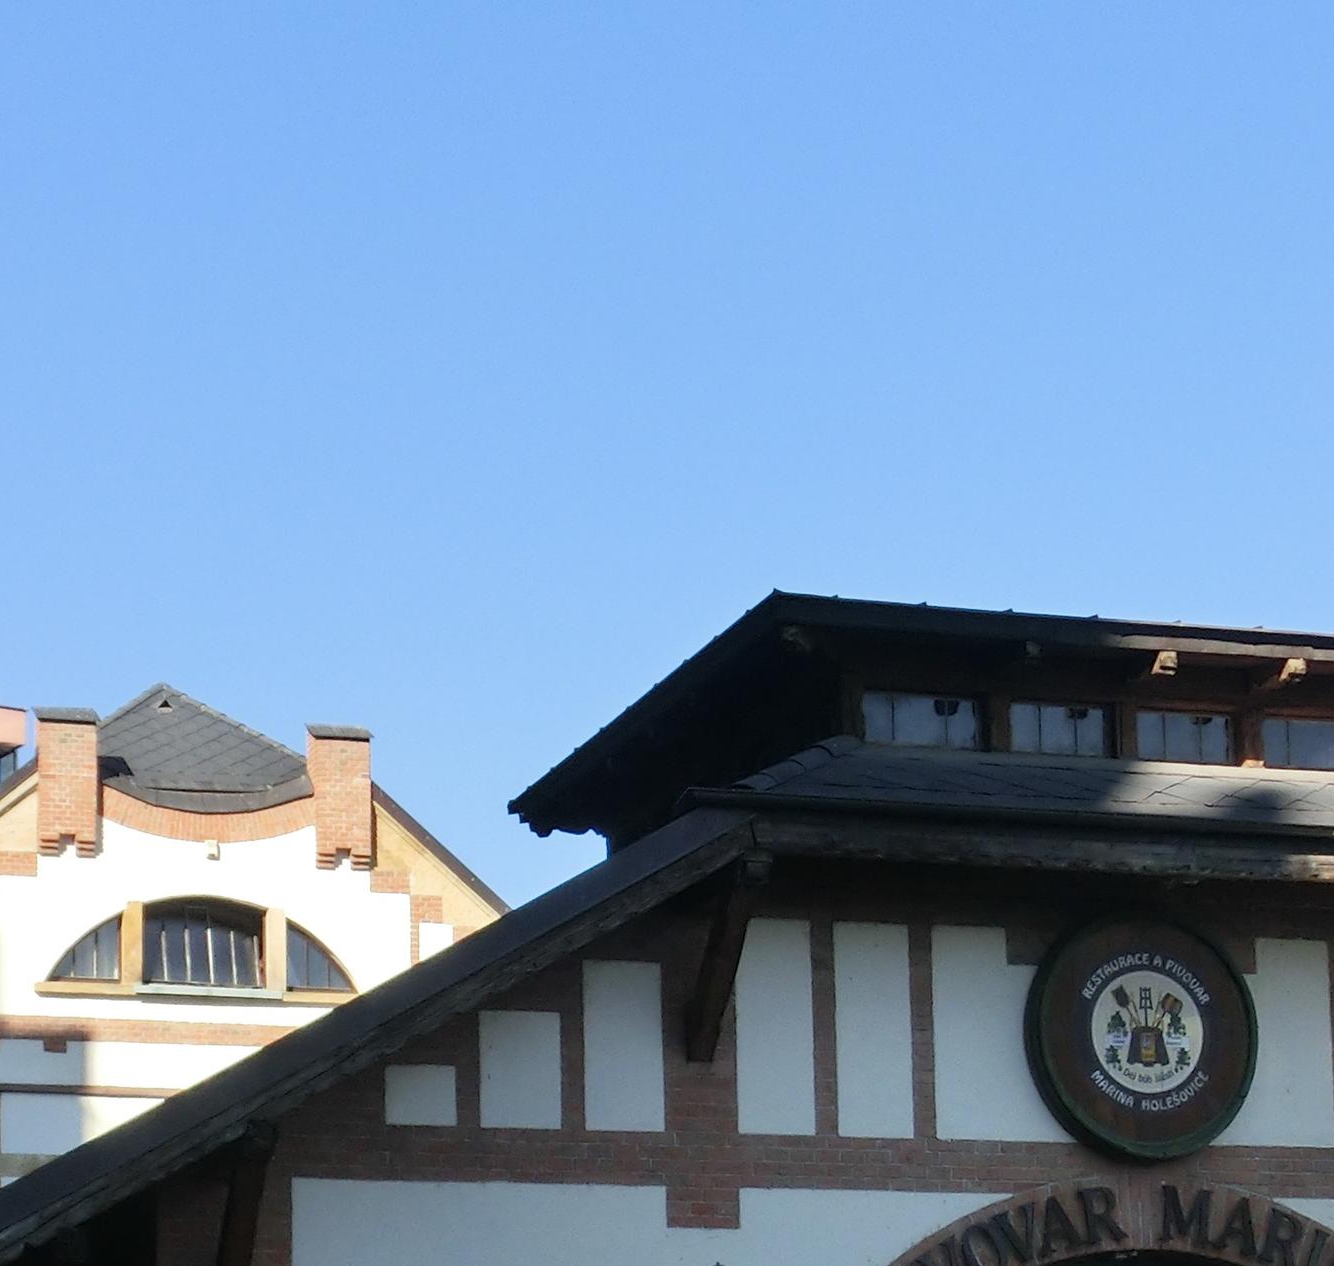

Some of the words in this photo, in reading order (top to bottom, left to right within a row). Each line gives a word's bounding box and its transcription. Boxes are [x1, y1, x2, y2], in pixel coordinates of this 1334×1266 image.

[1082, 953, 1149, 999] RESTAURACE
[1152, 955, 1163, 967] A
[1166, 958, 1210, 1005] PIVOVAR
[1090, 1070, 1134, 1108] MARINA
[1141, 1070, 1209, 1111] HOLEŠOVICE
